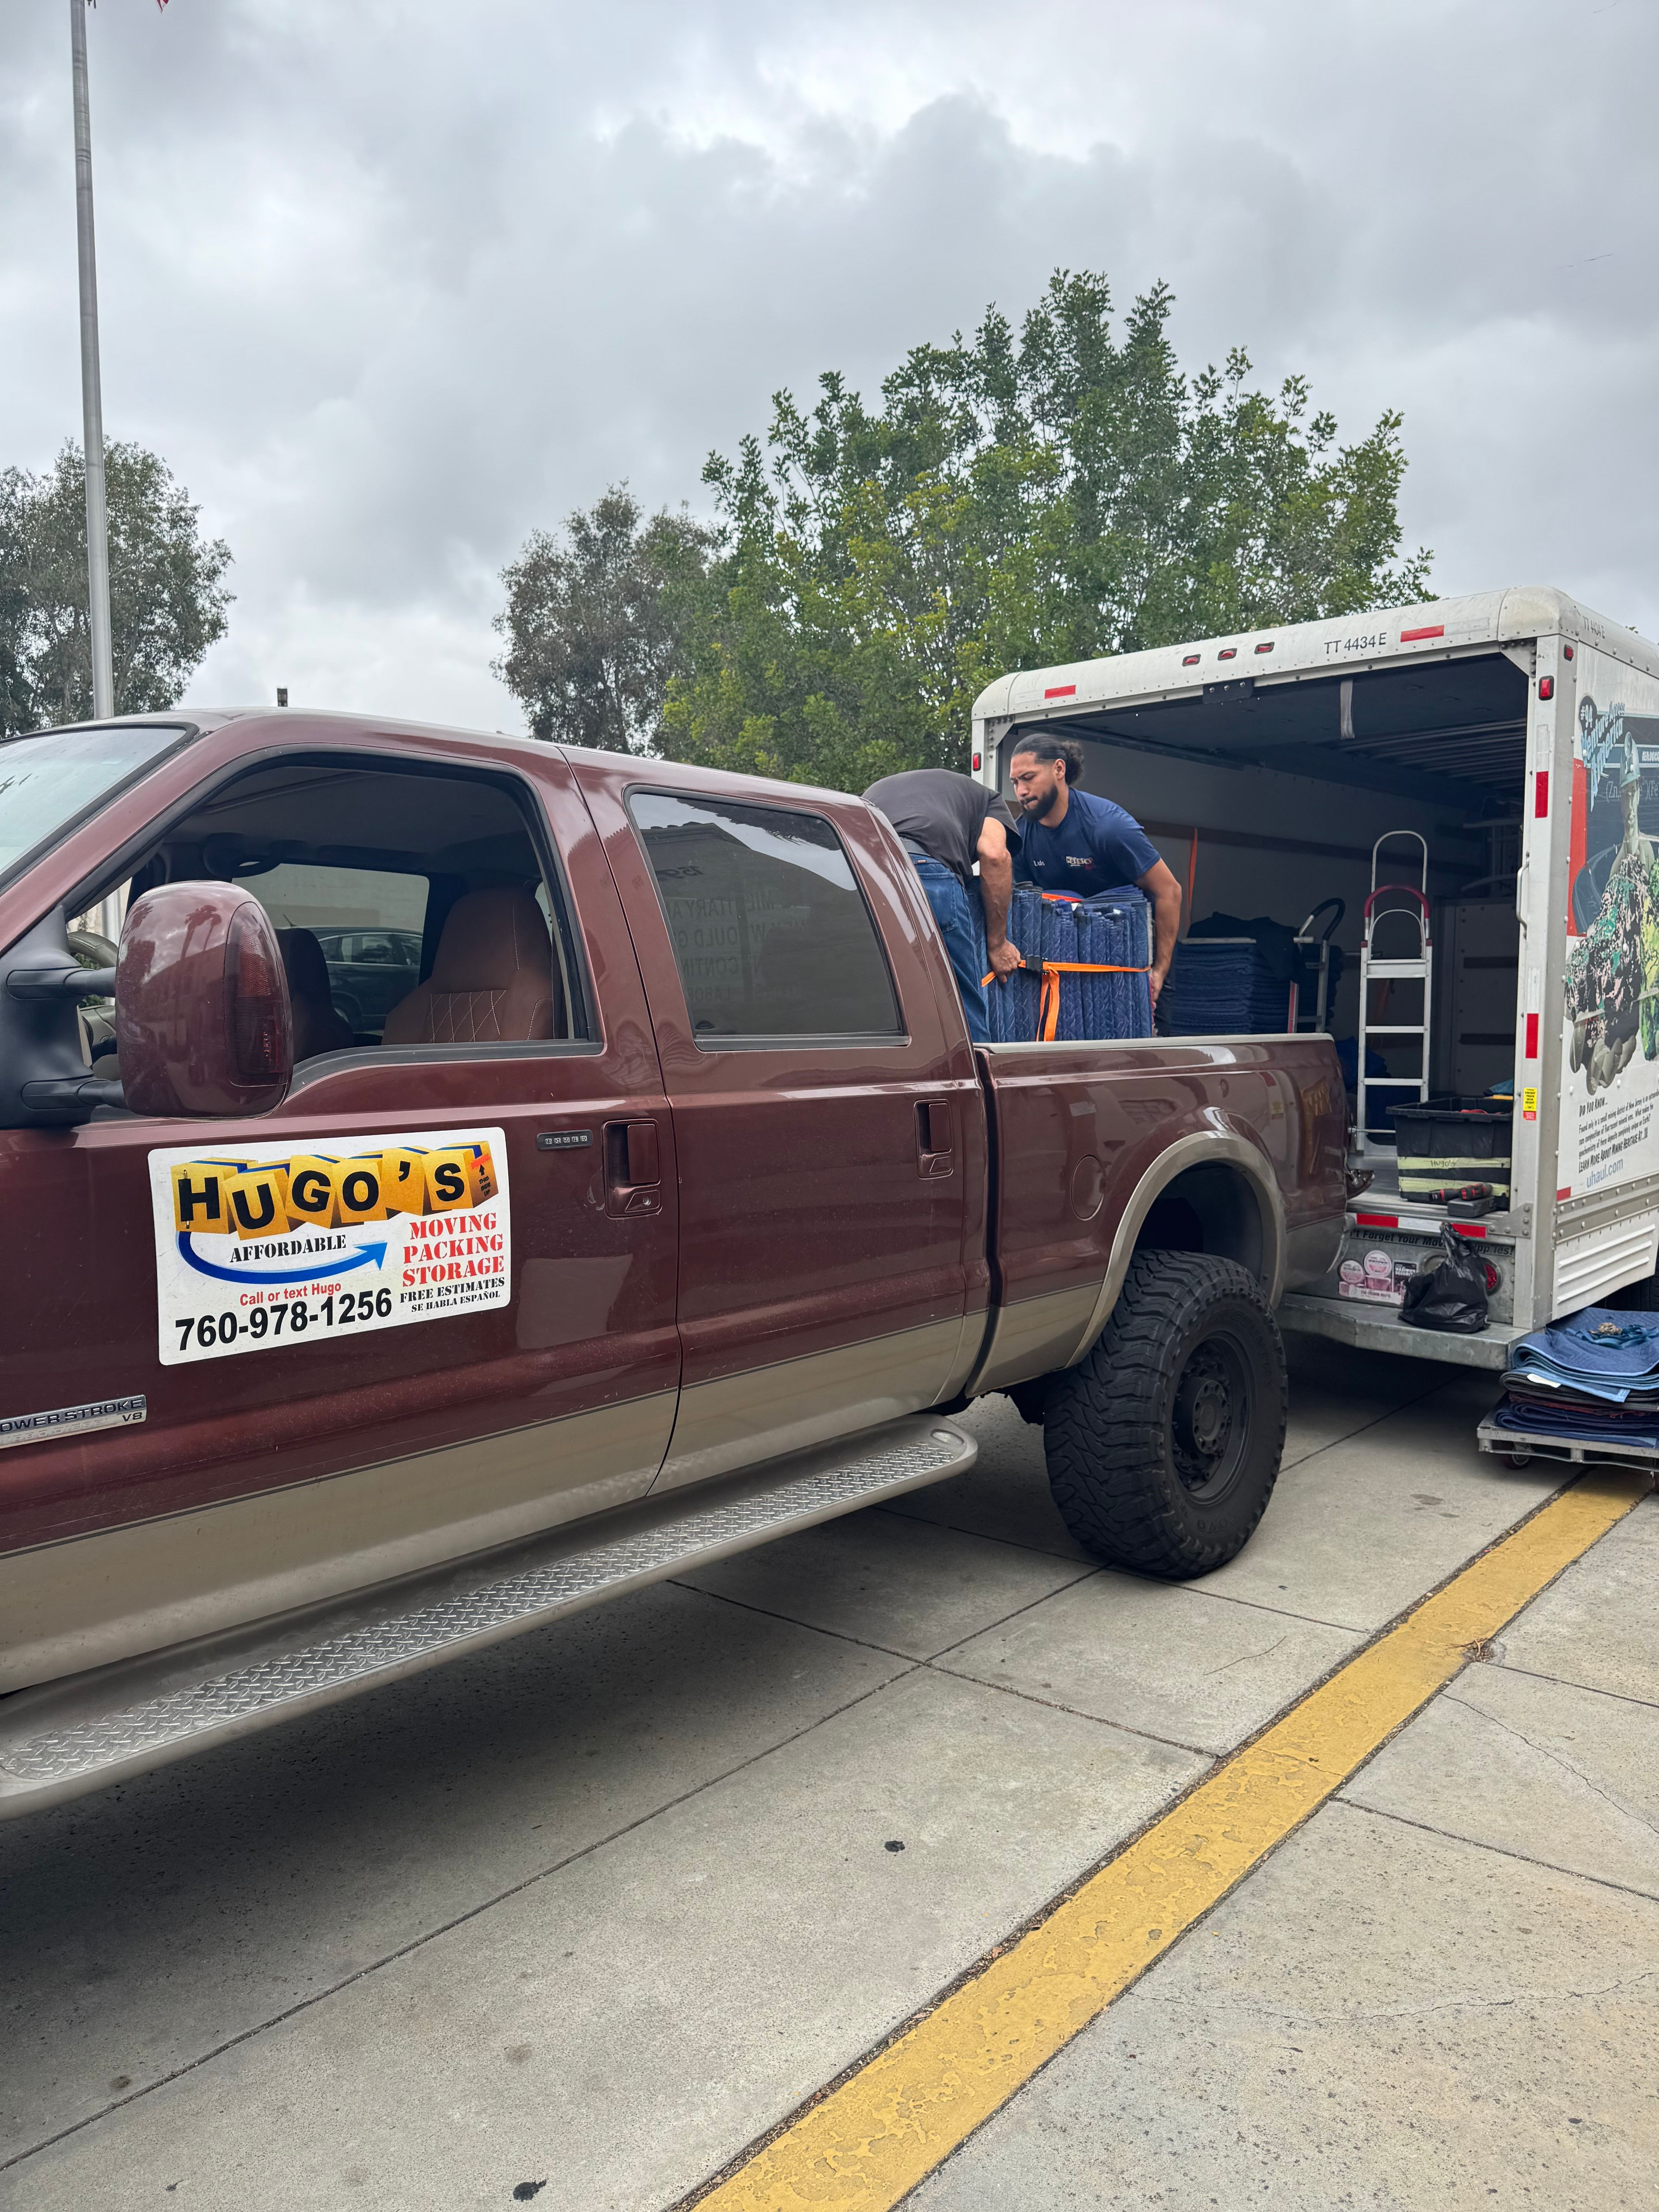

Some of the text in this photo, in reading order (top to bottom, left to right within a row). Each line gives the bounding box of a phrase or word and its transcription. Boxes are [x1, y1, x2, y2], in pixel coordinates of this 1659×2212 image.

[1324, 632, 1387, 654] TT 4434 E
[1580, 704, 1593, 728] #94
[1587, 1159, 1623, 1188] uhaul.com
[178, 1160, 465, 1230] HUGO'S
[409, 1212, 496, 1240] MOVING
[1363, 1230, 1394, 1242] Forget
[1398, 1234, 1419, 1245] Your
[229, 1235, 346, 1263] AFFORDABLE
[403, 1233, 503, 1264] PACKING
[402, 1255, 504, 1287] STORAGE
[240, 1283, 342, 1306] Call or text Hugo
[400, 1277, 505, 1303] FREE ESTIMATES
[411, 1290, 500, 1312] SE HABLA ESPAÑOL
[175, 1288, 392, 1351] 760-978-1256
[0, 1399, 143, 1432] OWER STROKE
[122, 1412, 143, 1422] V8
